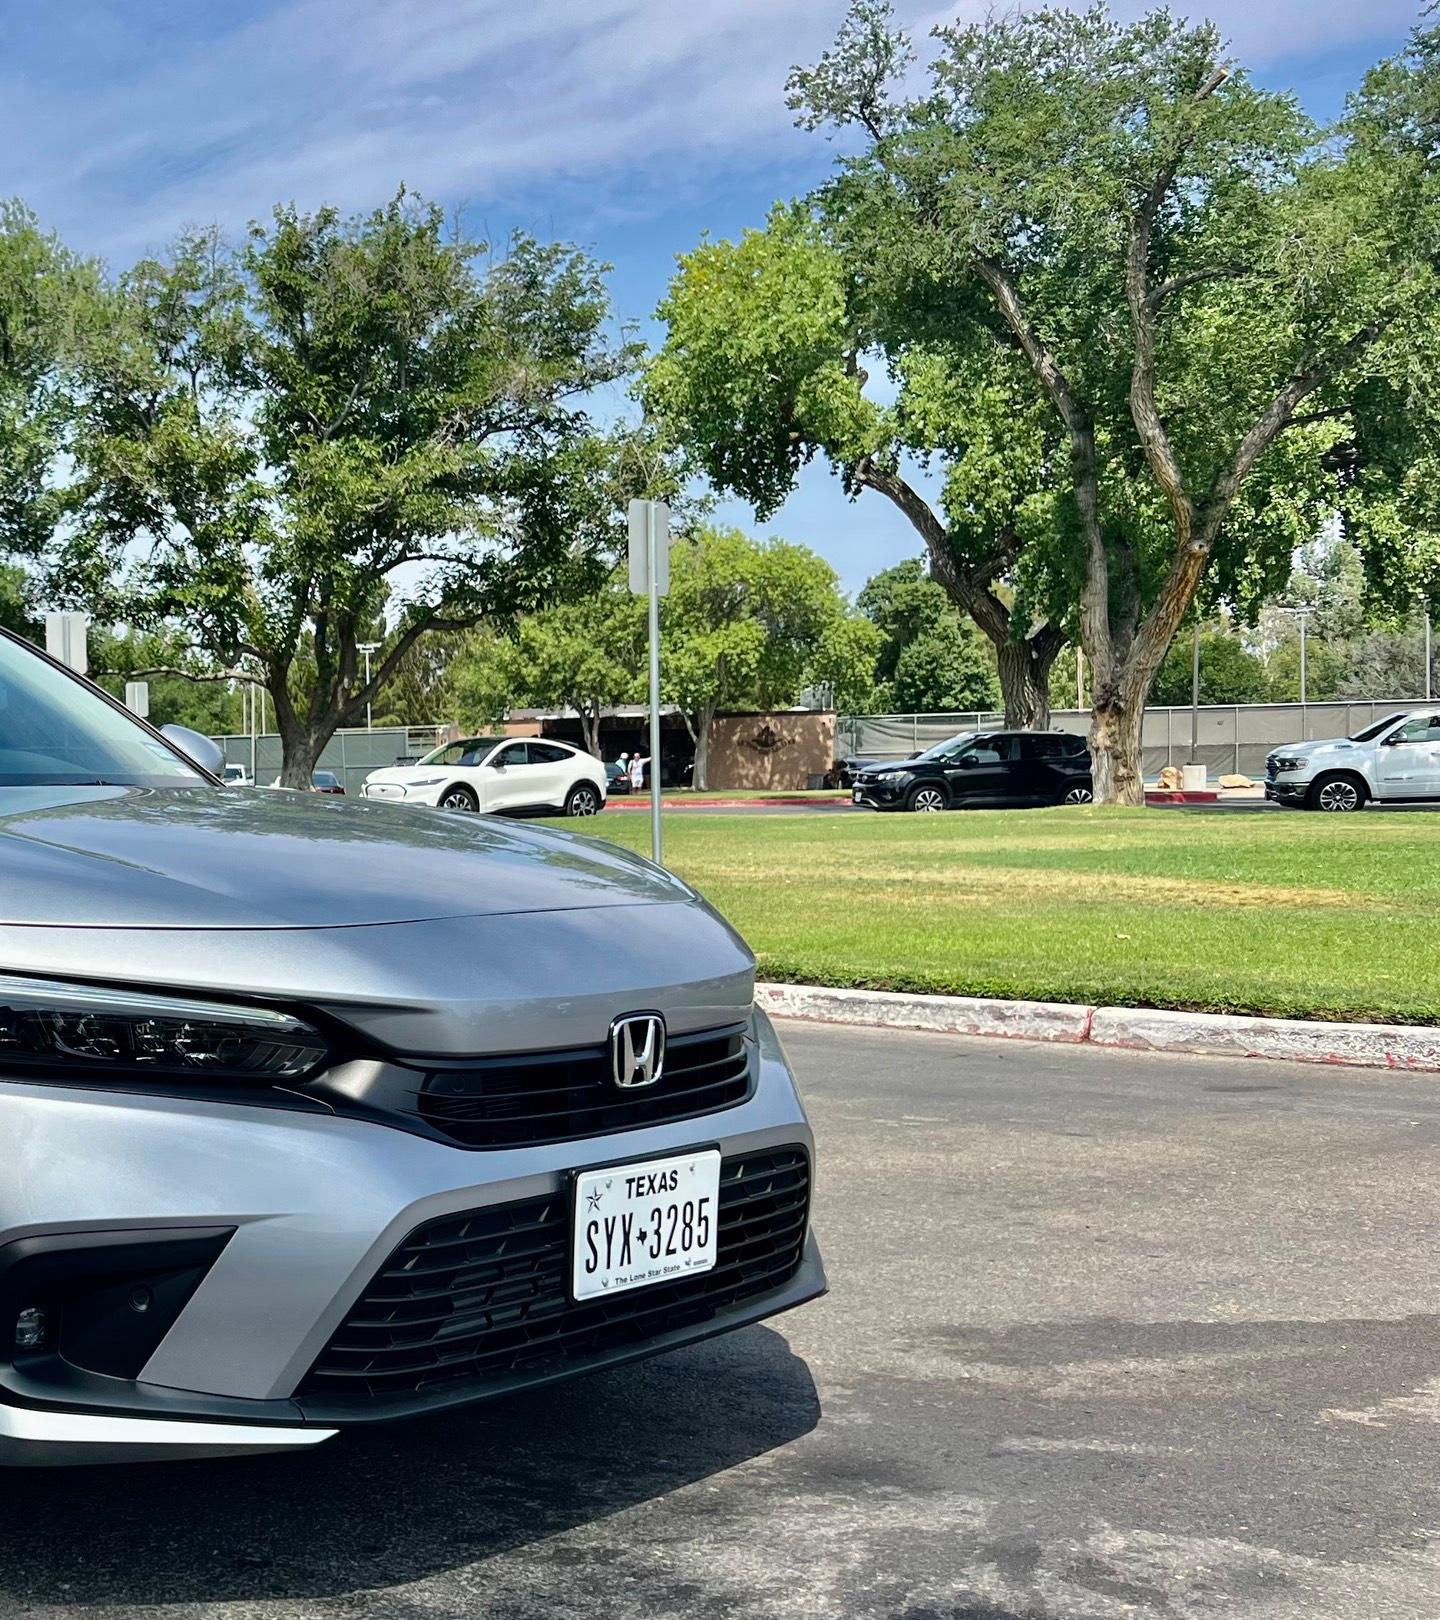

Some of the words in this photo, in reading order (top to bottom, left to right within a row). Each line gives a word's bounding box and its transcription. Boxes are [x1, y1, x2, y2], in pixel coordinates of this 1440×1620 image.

[626, 1169, 678, 1199] TEXAS
[585, 1212, 633, 1274] SYX
[649, 1197, 710, 1260] 3285
[615, 1276, 628, 1285] The
[629, 1273, 646, 1282] Lone
[647, 1268, 662, 1278] Star
[663, 1264, 681, 1274] State
